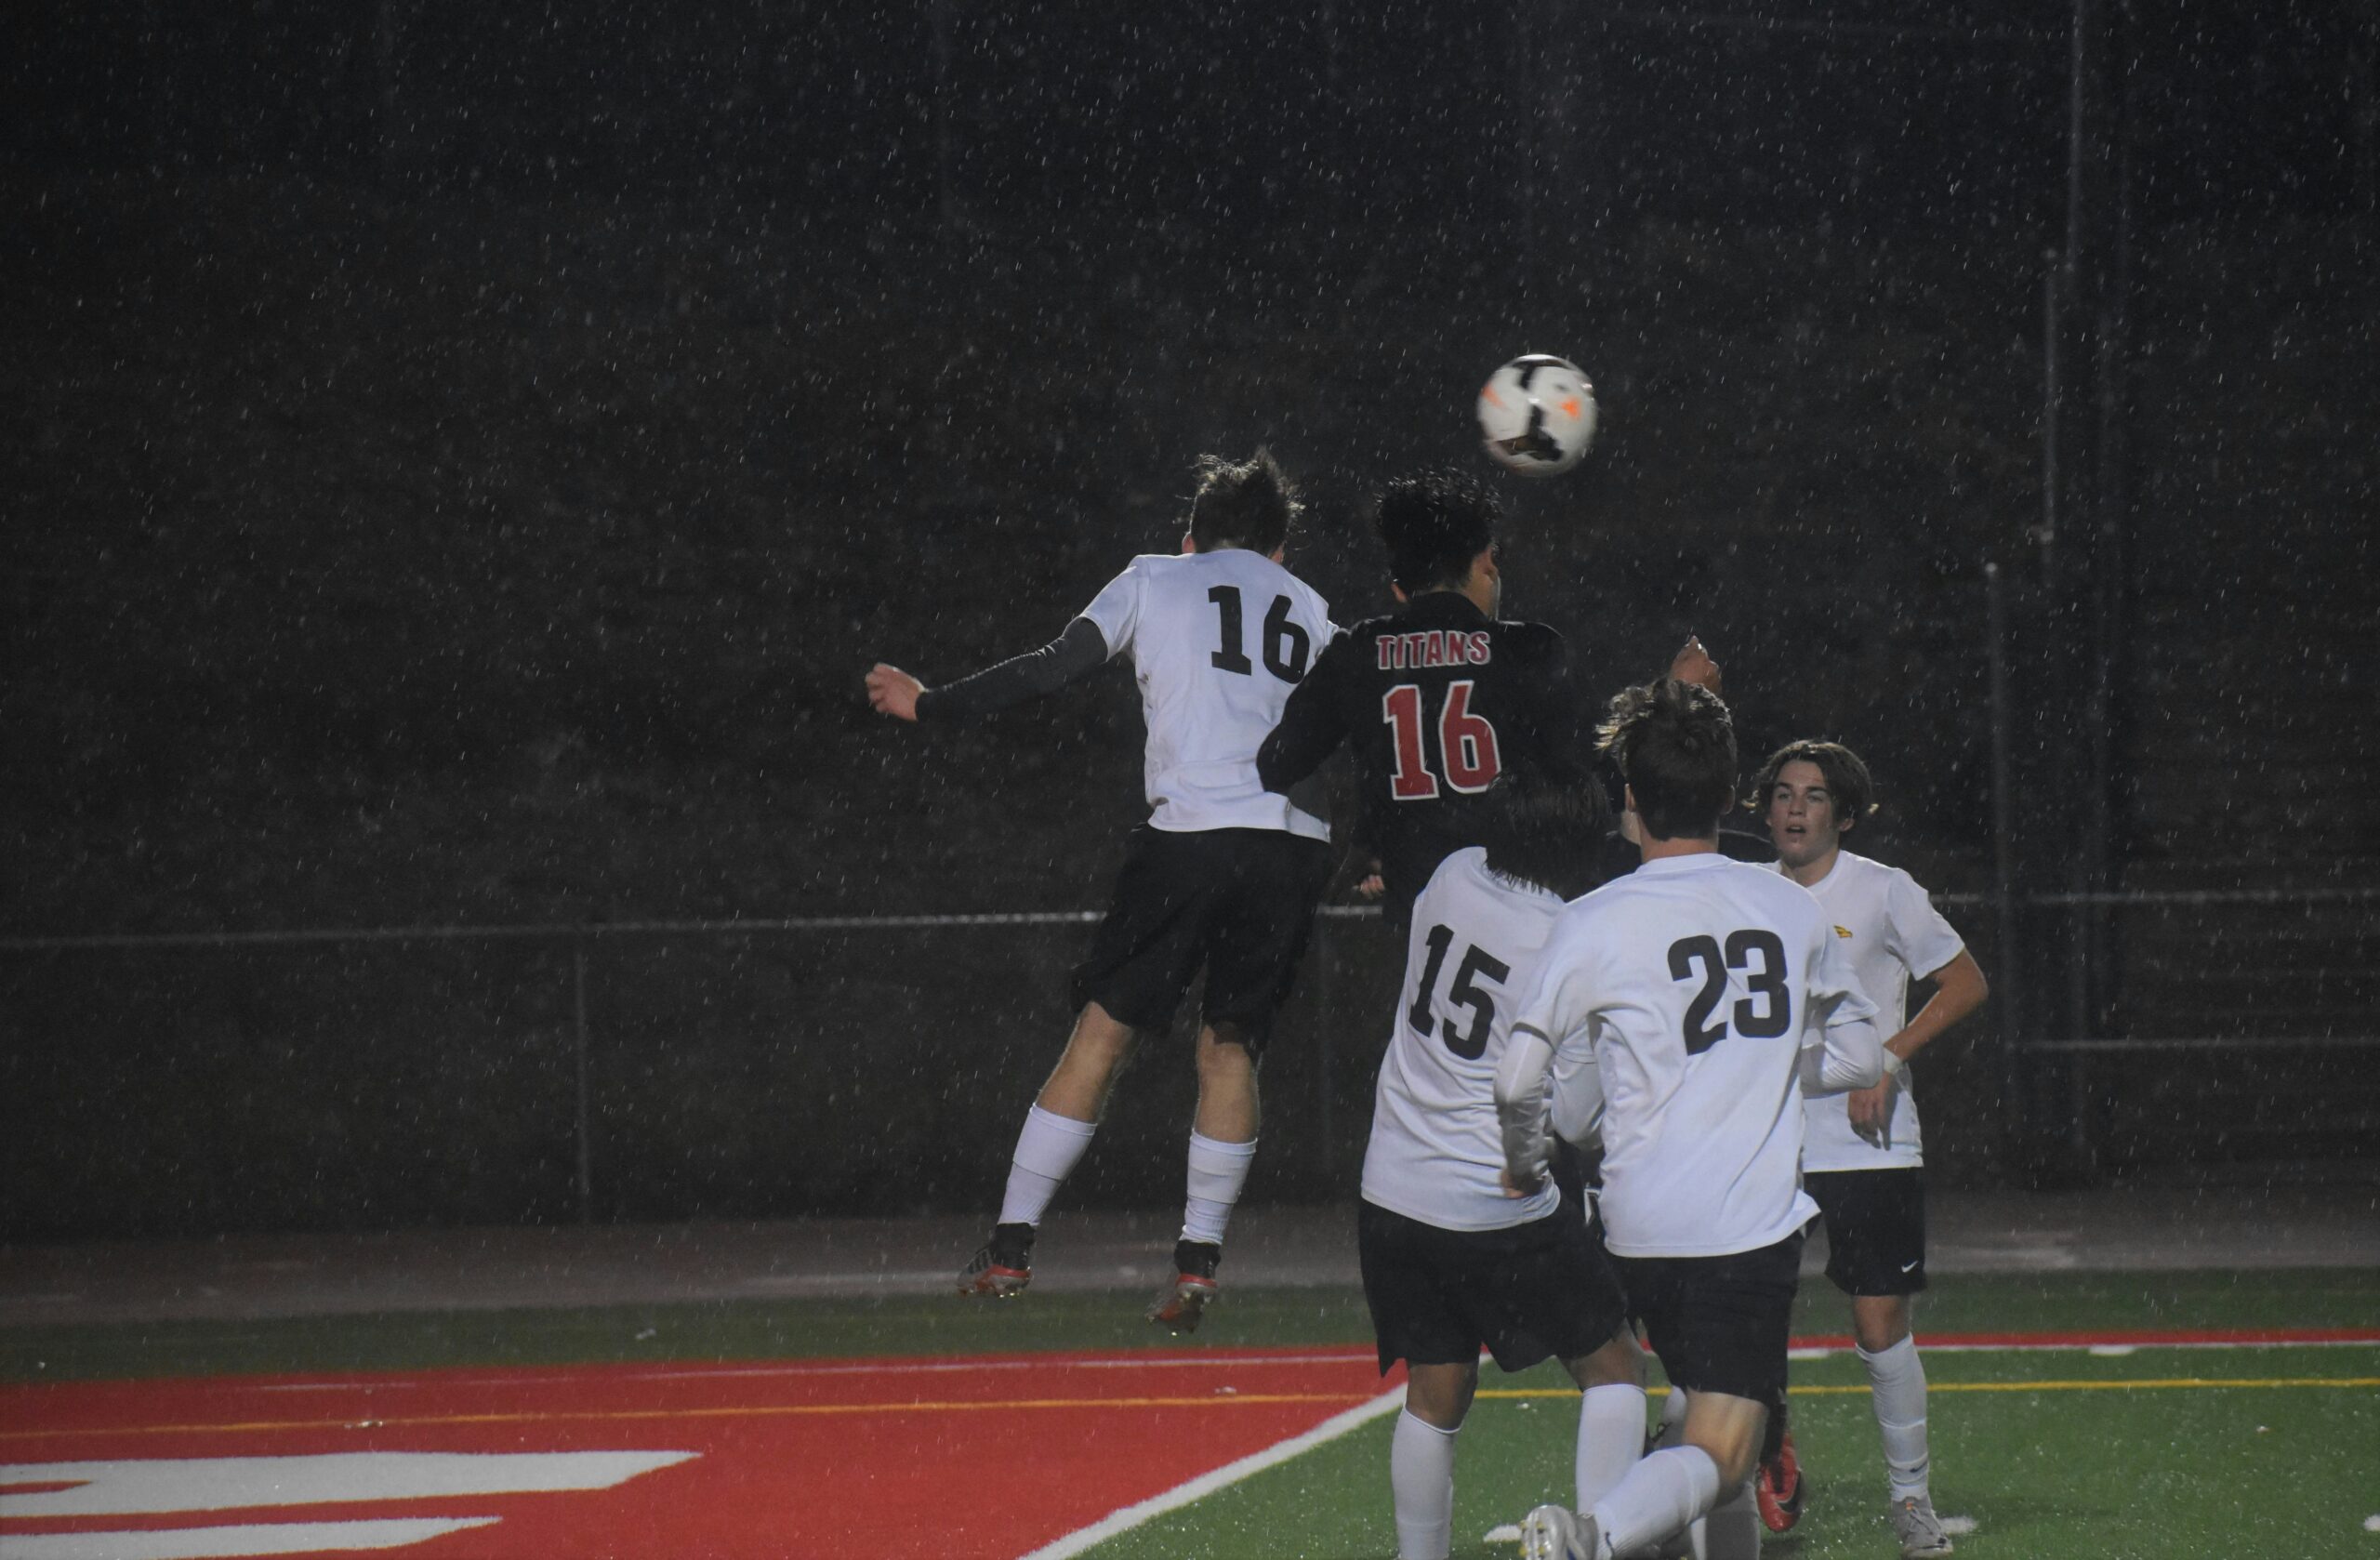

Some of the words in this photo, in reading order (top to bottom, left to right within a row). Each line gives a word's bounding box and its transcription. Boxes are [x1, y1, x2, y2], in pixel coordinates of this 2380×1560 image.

[1209, 585, 1310, 684] 16
[1377, 630, 1490, 670] TITANS
[1382, 680, 1501, 800] 16
[1409, 924, 1511, 1060] 15
[1668, 930, 1791, 1055] 23
